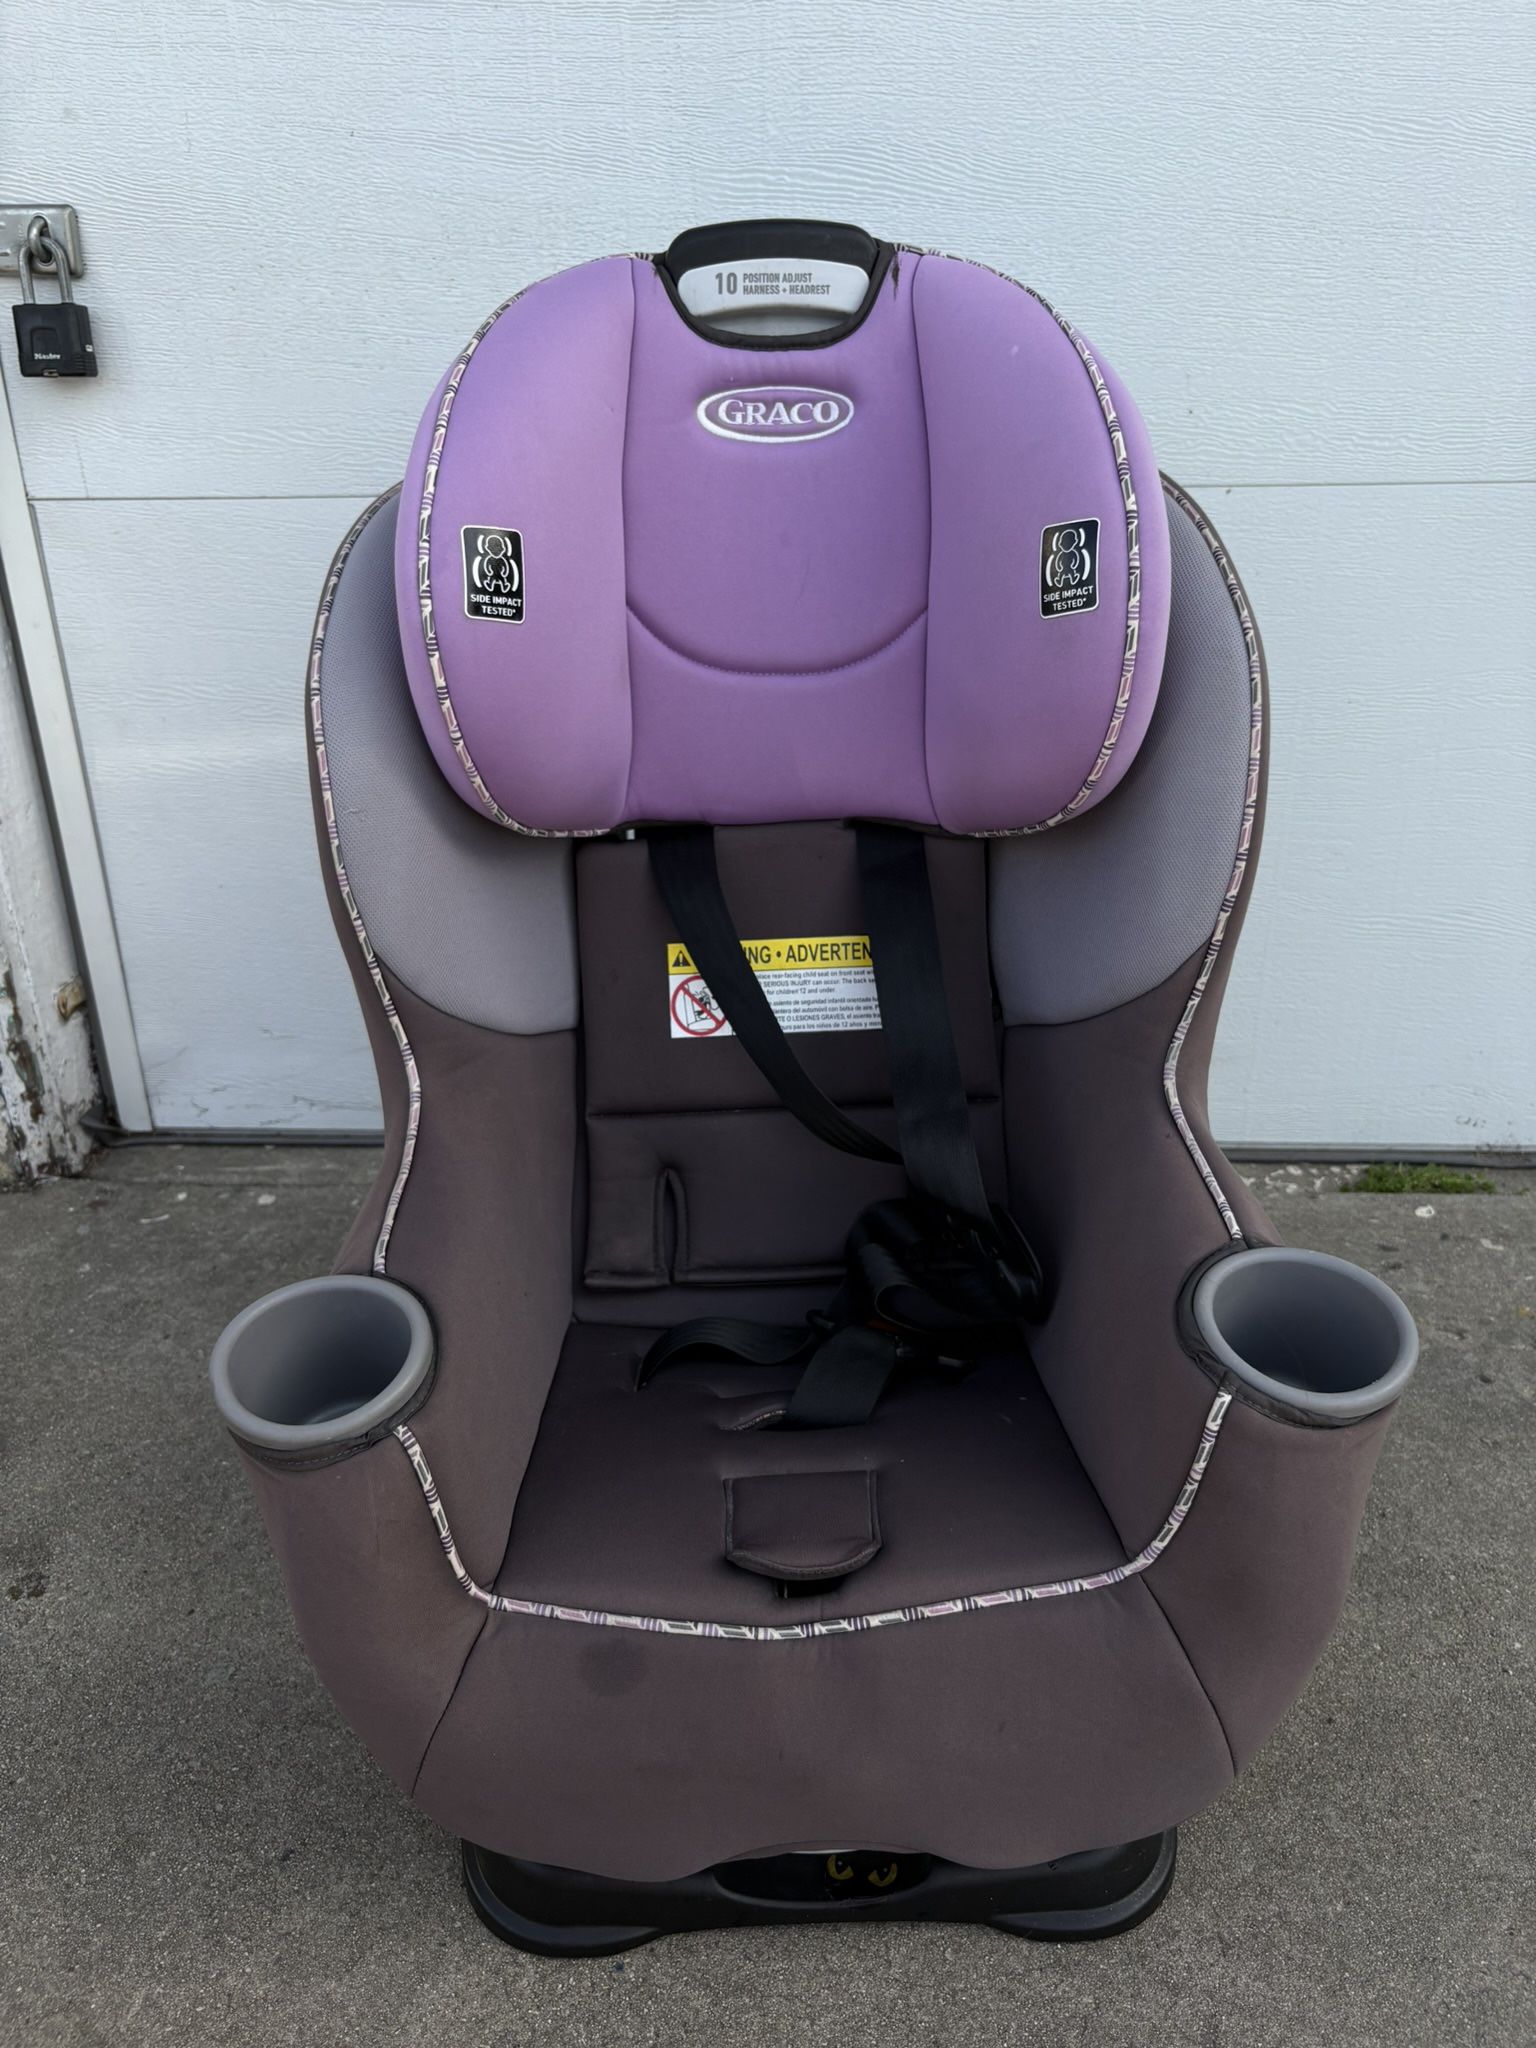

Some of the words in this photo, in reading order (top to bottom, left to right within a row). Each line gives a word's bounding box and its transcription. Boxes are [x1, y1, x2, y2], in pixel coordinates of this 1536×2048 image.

[715, 272, 738, 295] 10
[743, 272, 780, 284] POSITION
[782, 272, 812, 284] ADJUST
[743, 284, 780, 296] HARNESS
[788, 284, 830, 296] HEADREST
[718, 399, 840, 426] GRACO
[470, 594, 491, 604] SIDE
[493, 596, 522, 607] IMPACT
[1043, 592, 1060, 602] SIDE
[1062, 586, 1093, 598] IMPACT
[786, 942, 872, 963] ADVERTEN
